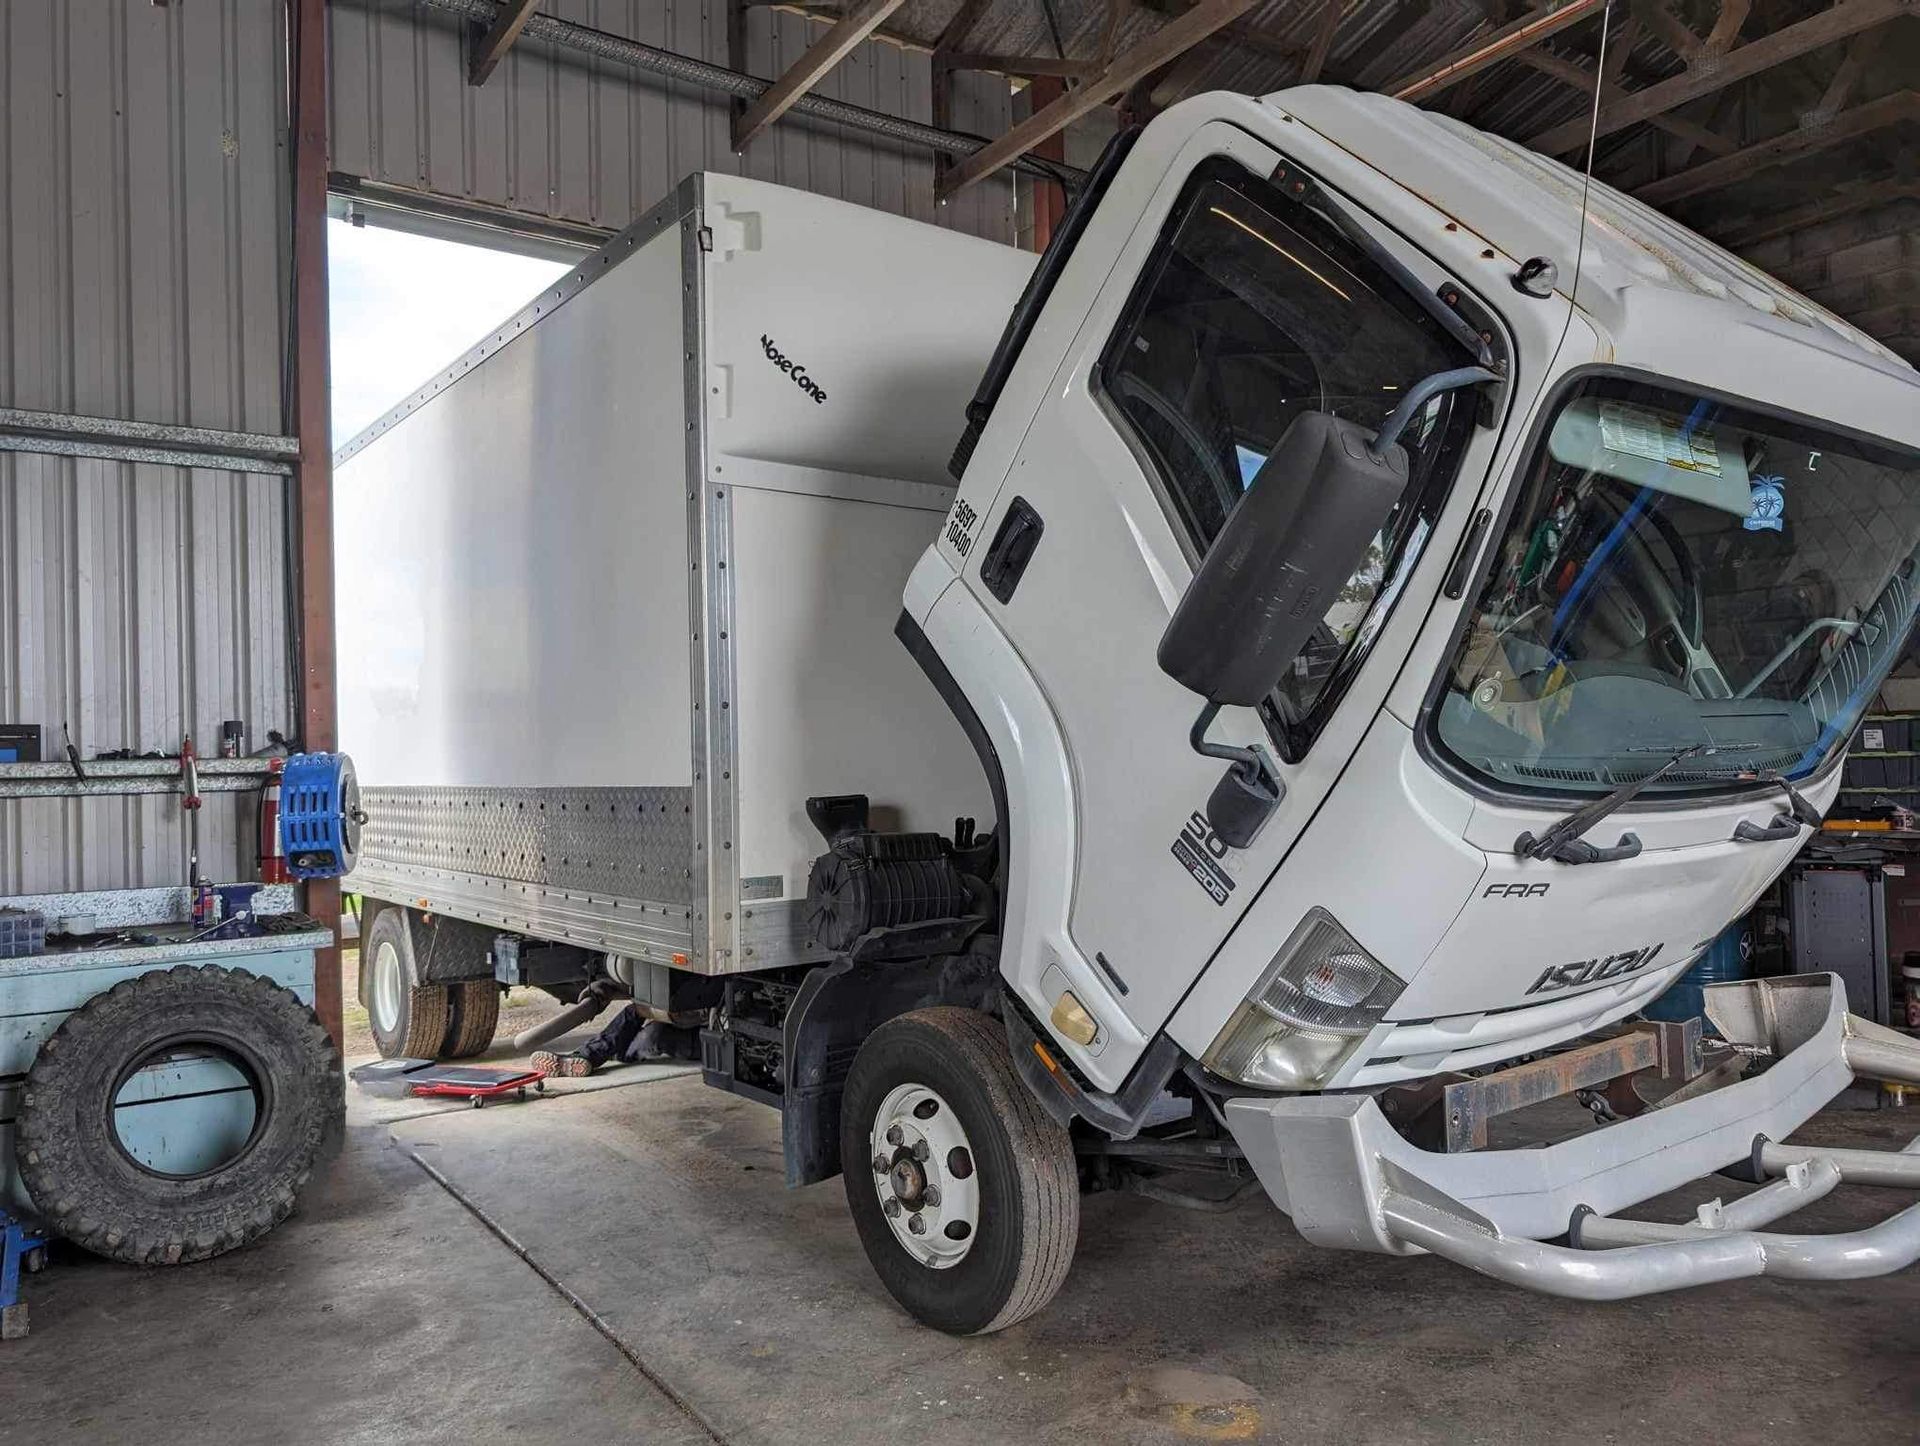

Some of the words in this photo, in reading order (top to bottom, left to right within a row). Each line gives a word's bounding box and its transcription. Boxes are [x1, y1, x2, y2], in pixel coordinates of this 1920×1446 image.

[954, 498, 978, 532] 5697
[945, 520, 972, 558] 10400
[1482, 882, 1551, 899] FRR
[1523, 942, 1665, 996] ISUZU
